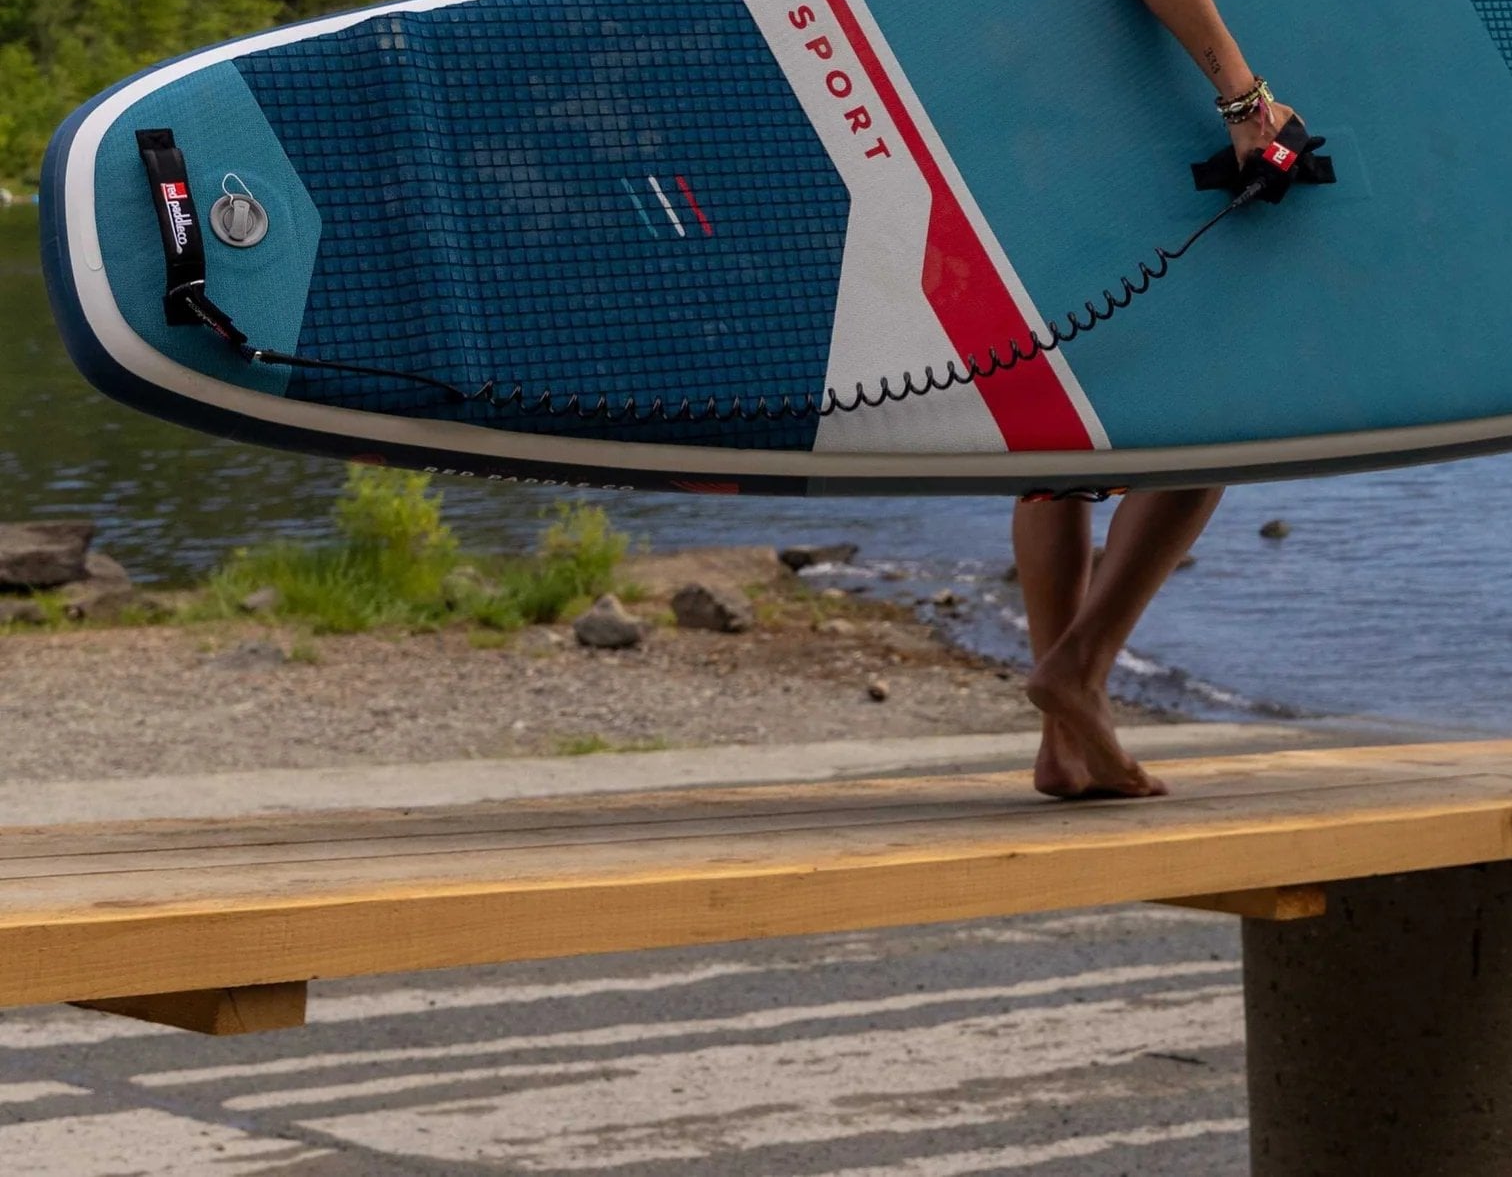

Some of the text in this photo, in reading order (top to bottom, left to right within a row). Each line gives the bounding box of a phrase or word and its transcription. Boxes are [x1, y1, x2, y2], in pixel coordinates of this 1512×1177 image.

[788, 5, 891, 159] SPORT
[1272, 141, 1291, 164] red
[165, 183, 188, 200] red
